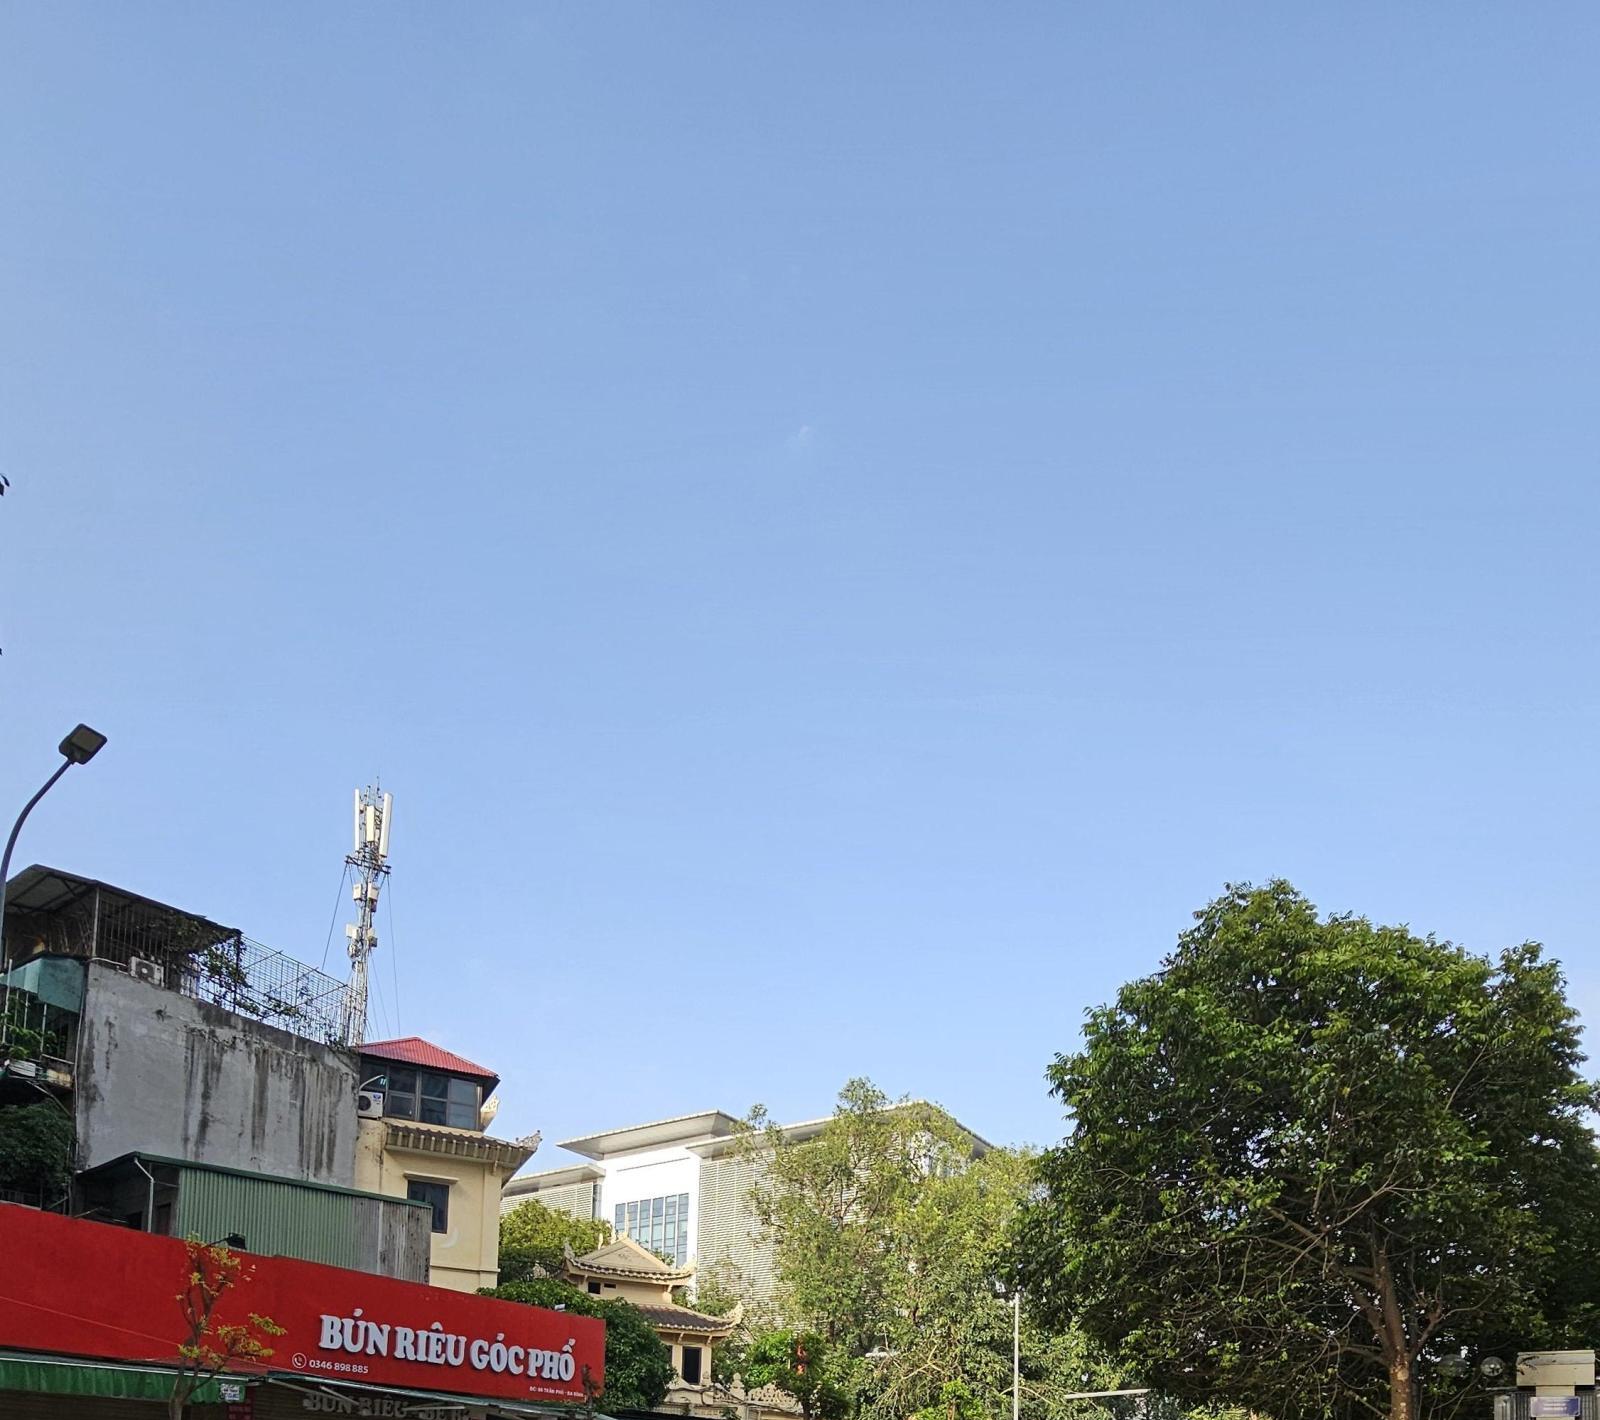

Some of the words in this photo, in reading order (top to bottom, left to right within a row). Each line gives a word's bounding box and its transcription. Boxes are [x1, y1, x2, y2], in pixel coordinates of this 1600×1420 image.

[309, 1359, 333, 1370] 0346
[334, 1362, 351, 1372] 898
[352, 1365, 369, 1374] 885
[318, 1308, 391, 1357] BÚN
[394, 1321, 467, 1366] RIÊU
[470, 1333, 525, 1375] GÓC
[527, 1338, 576, 1381] PHỐ
